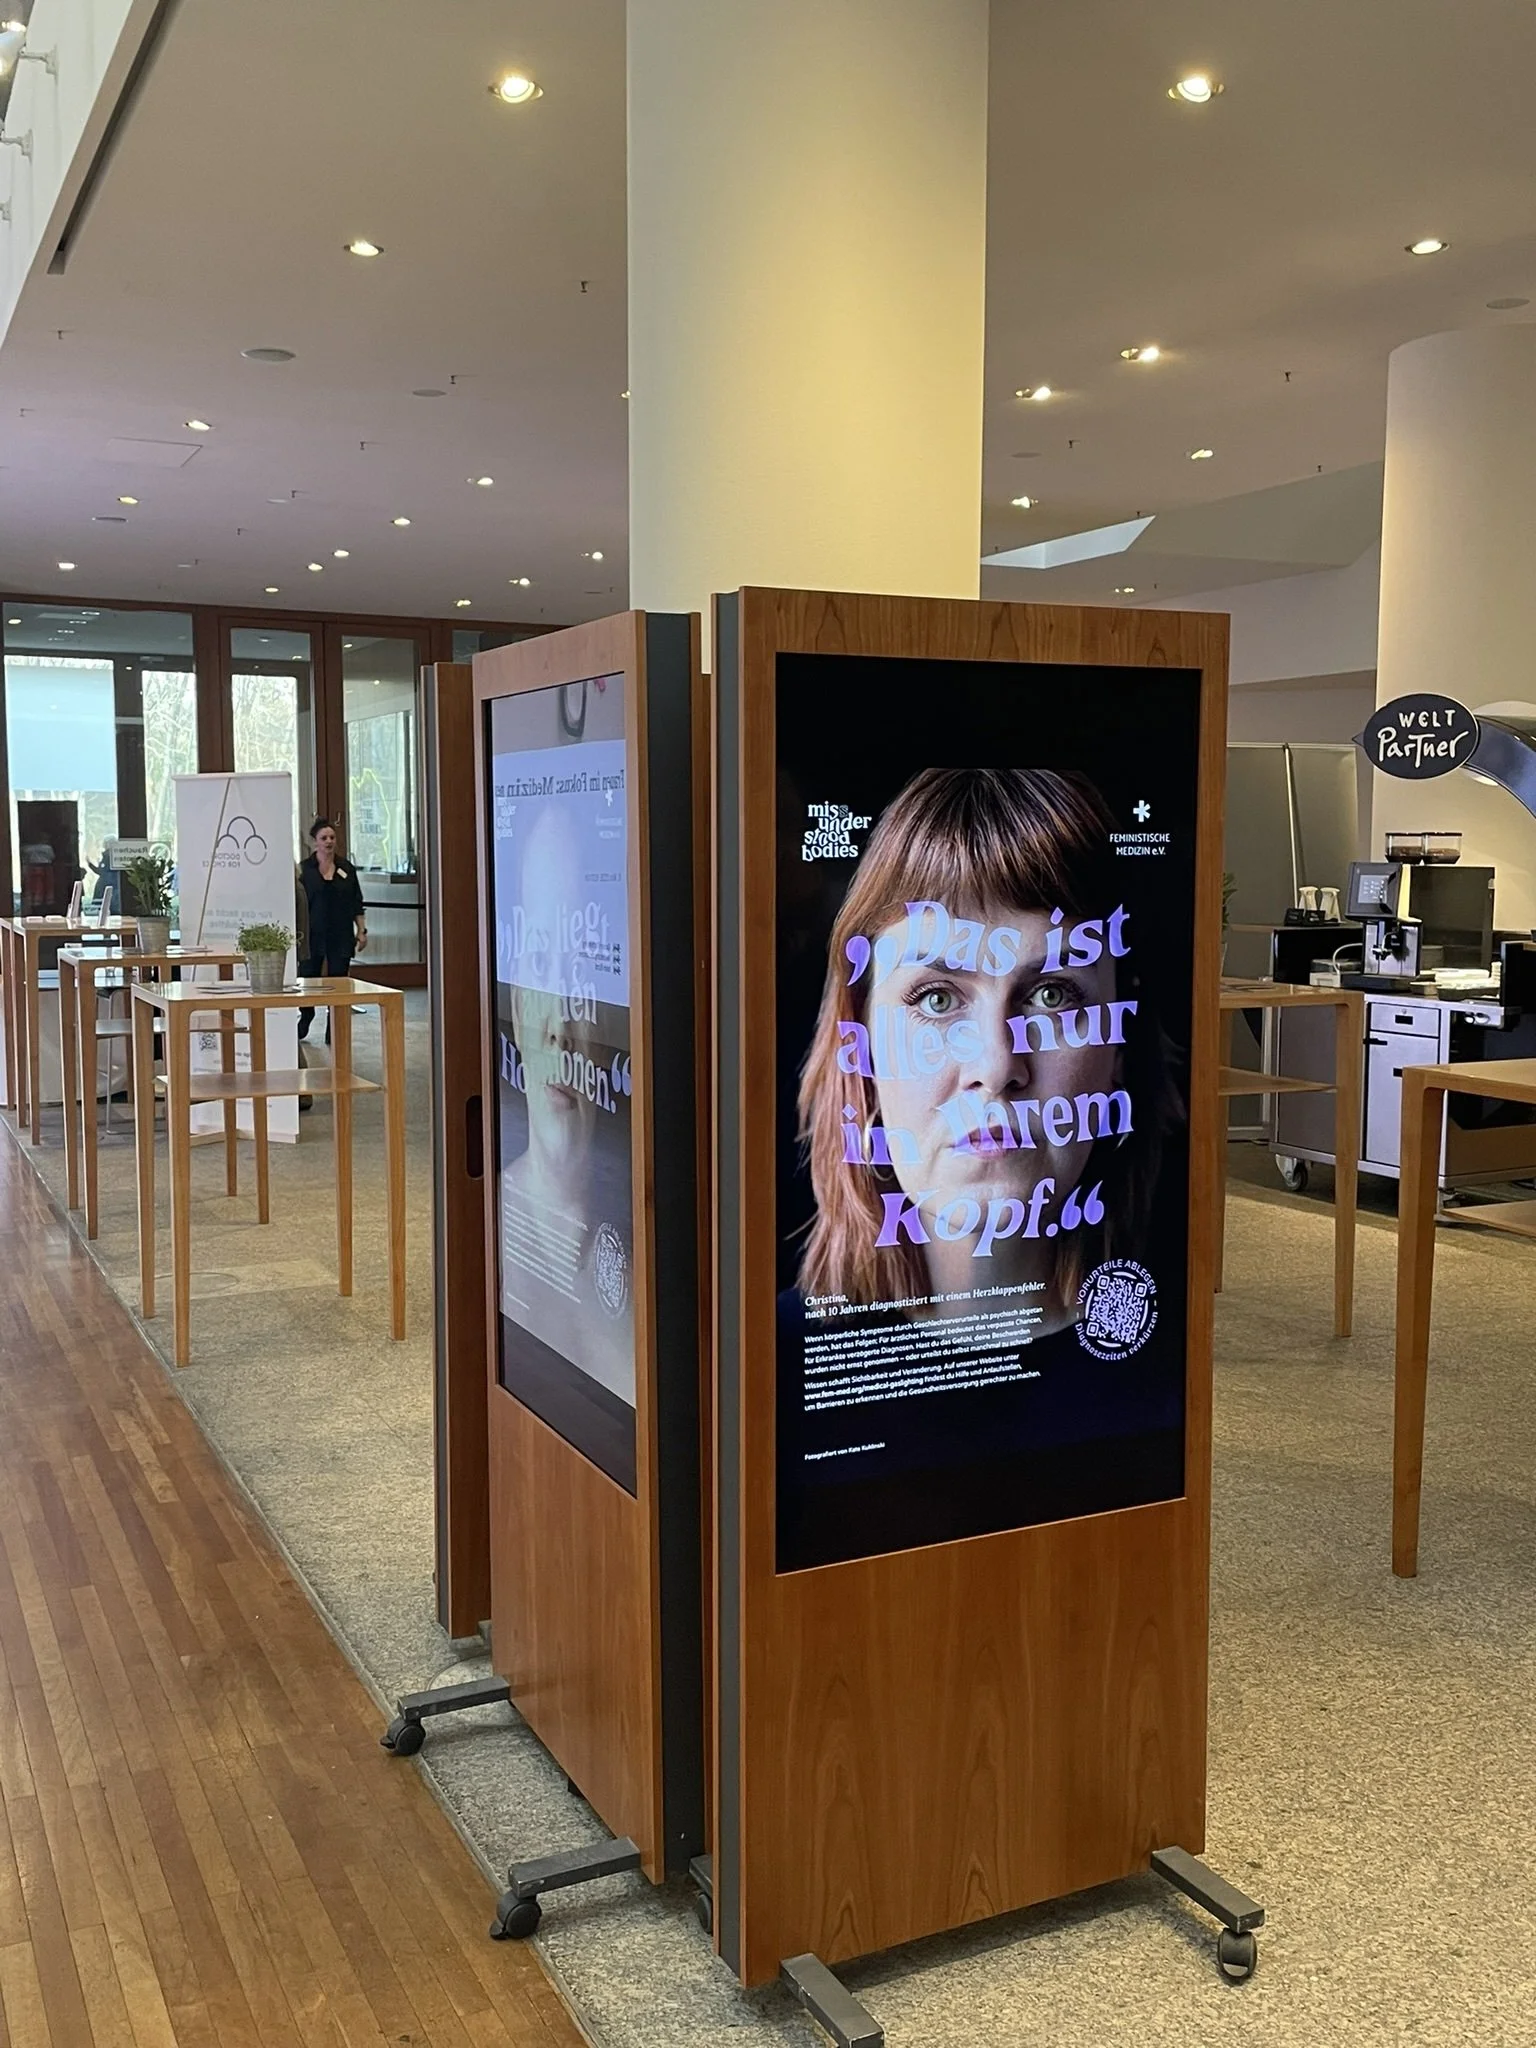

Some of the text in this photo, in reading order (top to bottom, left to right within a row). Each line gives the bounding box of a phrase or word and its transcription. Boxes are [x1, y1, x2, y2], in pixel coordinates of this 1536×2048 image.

[1398, 709, 1456, 727] WELT
[804, 829, 850, 846] stood
[818, 812, 872, 833] under
[1109, 833, 1171, 843] FEMINISTISCHE
[801, 843, 859, 861] bodies
[1116, 846, 1166, 856] MEDIZIN e.V.
[557, 902, 610, 958] liegt
[1040, 904, 1132, 974] ist
[836, 1001, 1138, 1080] alles nur
[841, 1088, 1134, 1166] in Ihrem
[1076, 1259, 1157, 1305] VORURTEILE ABLEGEN
[805, 1295, 849, 1306] Christina,
[805, 1309, 827, 1319] nach
[829, 1308, 838, 1316] 10
[840, 1306, 868, 1315] Jahren
[870, 1297, 927, 1311] diagnostiziert
[929, 1295, 944, 1304] mit
[973, 1282, 1046, 1298] Herzklappenfehler.
[804, 1346, 830, 1354] werden,
[890, 1334, 919, 1342] ärztliches
[920, 1329, 946, 1338] Personal
[947, 1326, 974, 1335] bedeutet
[987, 1321, 1014, 1330] verpasste
[824, 1330, 859, 1340] körperliche
[860, 1327, 893, 1336] Symptome
[894, 1323, 912, 1331] durch
[990, 1310, 1018, 1320] psychisch
[1019, 1308, 1043, 1316] abgetan
[1075, 1311, 1158, 1360] Diagnosezeiten verkürzen
[804, 1367, 828, 1375] wurden
[830, 1363, 845, 1371] nicht
[847, 1361, 862, 1369] ernst
[864, 1358, 899, 1368] genommen
[921, 1350, 942, 1359] urteilst
[970, 1342, 1001, 1352] manchmal
[815, 1353, 846, 1363] Erkrankte
[847, 1349, 880, 1358] verzögerte
[881, 1346, 914, 1354] Diagnosen.
[952, 1336, 973, 1344] Gefühl,
[804, 1382, 827, 1390] Wissen
[829, 1377, 850, 1386] schafft
[852, 1372, 888, 1383] Sichtbarkeit
[902, 1366, 942, 1376] Veränderung.
[979, 1356, 1002, 1364] Website
[925, 1374, 945, 1383] findest
[816, 1400, 845, 1409] Barrieren
[855, 1395, 884, 1403] erkennen
[885, 1391, 897, 1399] und
[909, 1381, 979, 1395] Gesundheitsversorgung
[980, 1376, 1007, 1386] gerechter
